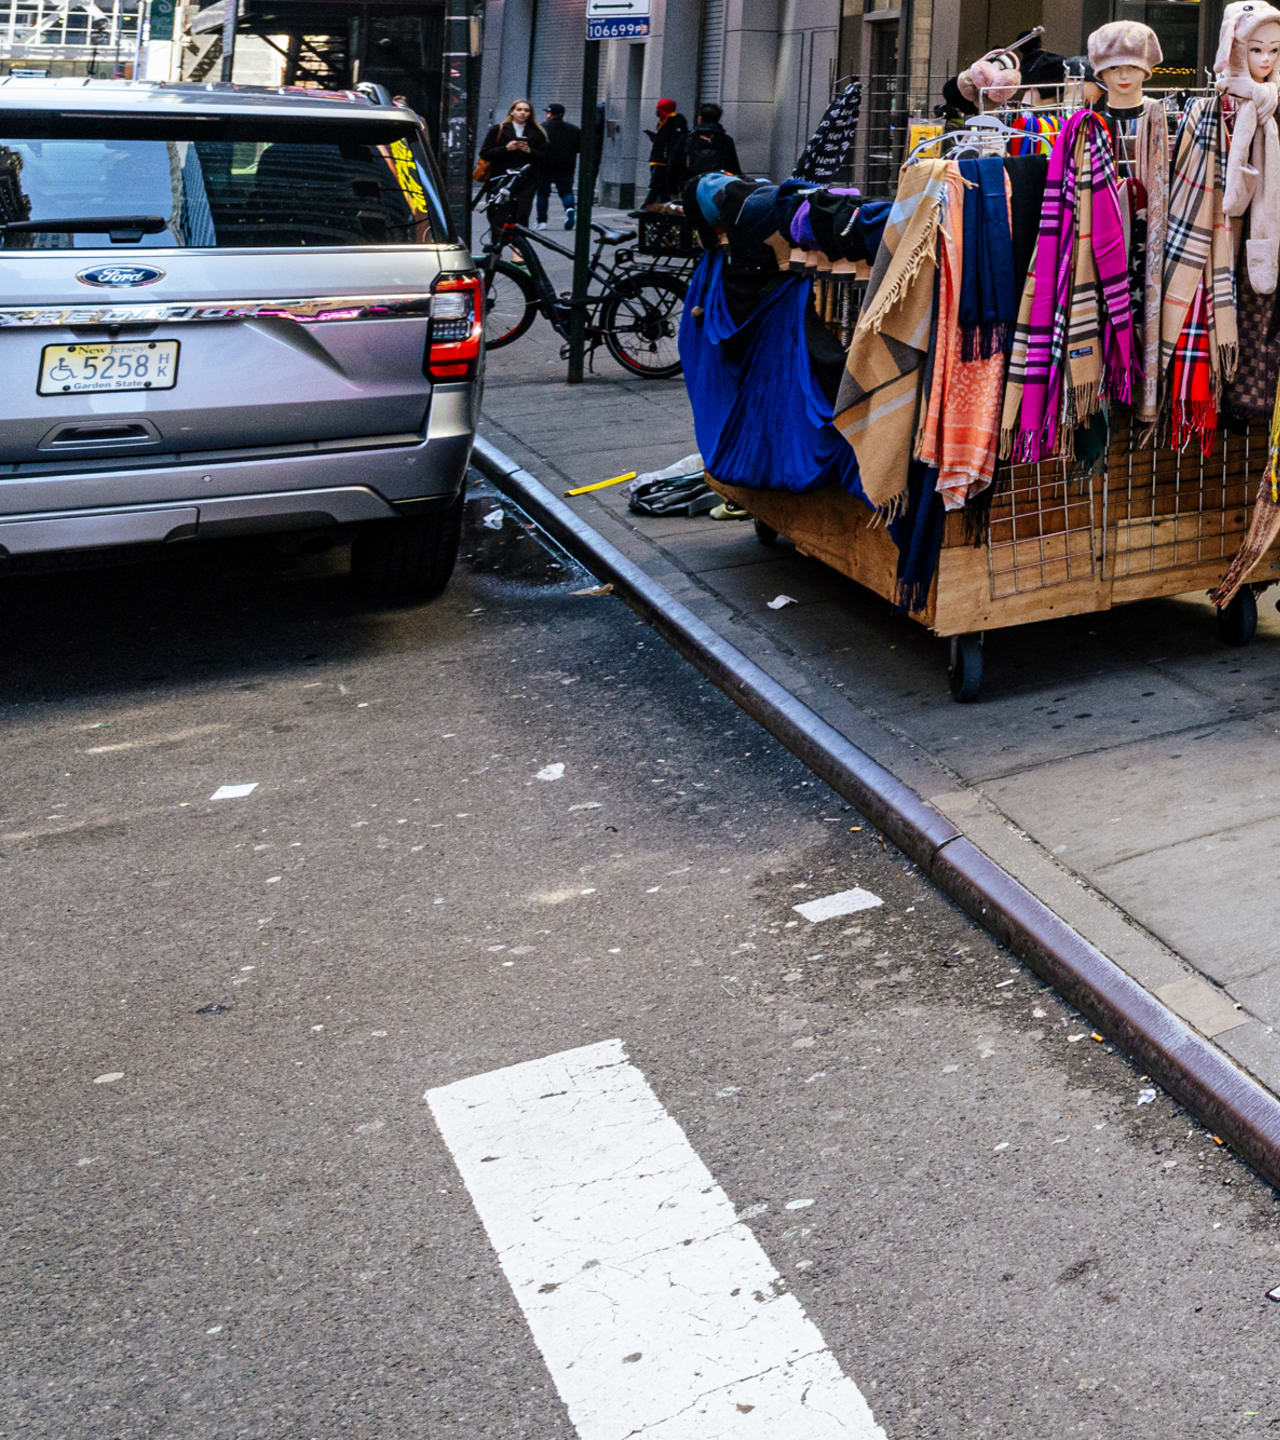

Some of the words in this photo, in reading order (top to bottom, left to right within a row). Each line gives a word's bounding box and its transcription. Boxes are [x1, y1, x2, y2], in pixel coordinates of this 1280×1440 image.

[97, 267, 145, 284] Ford
[0, 306, 263, 327] XPEDITION
[78, 345, 107, 355] New
[109, 344, 146, 356] Jersey
[82, 354, 150, 380] 5258
[158, 353, 170, 365] H
[157, 365, 167, 377] K
[73, 380, 112, 390] Garden
[115, 379, 143, 388] State
